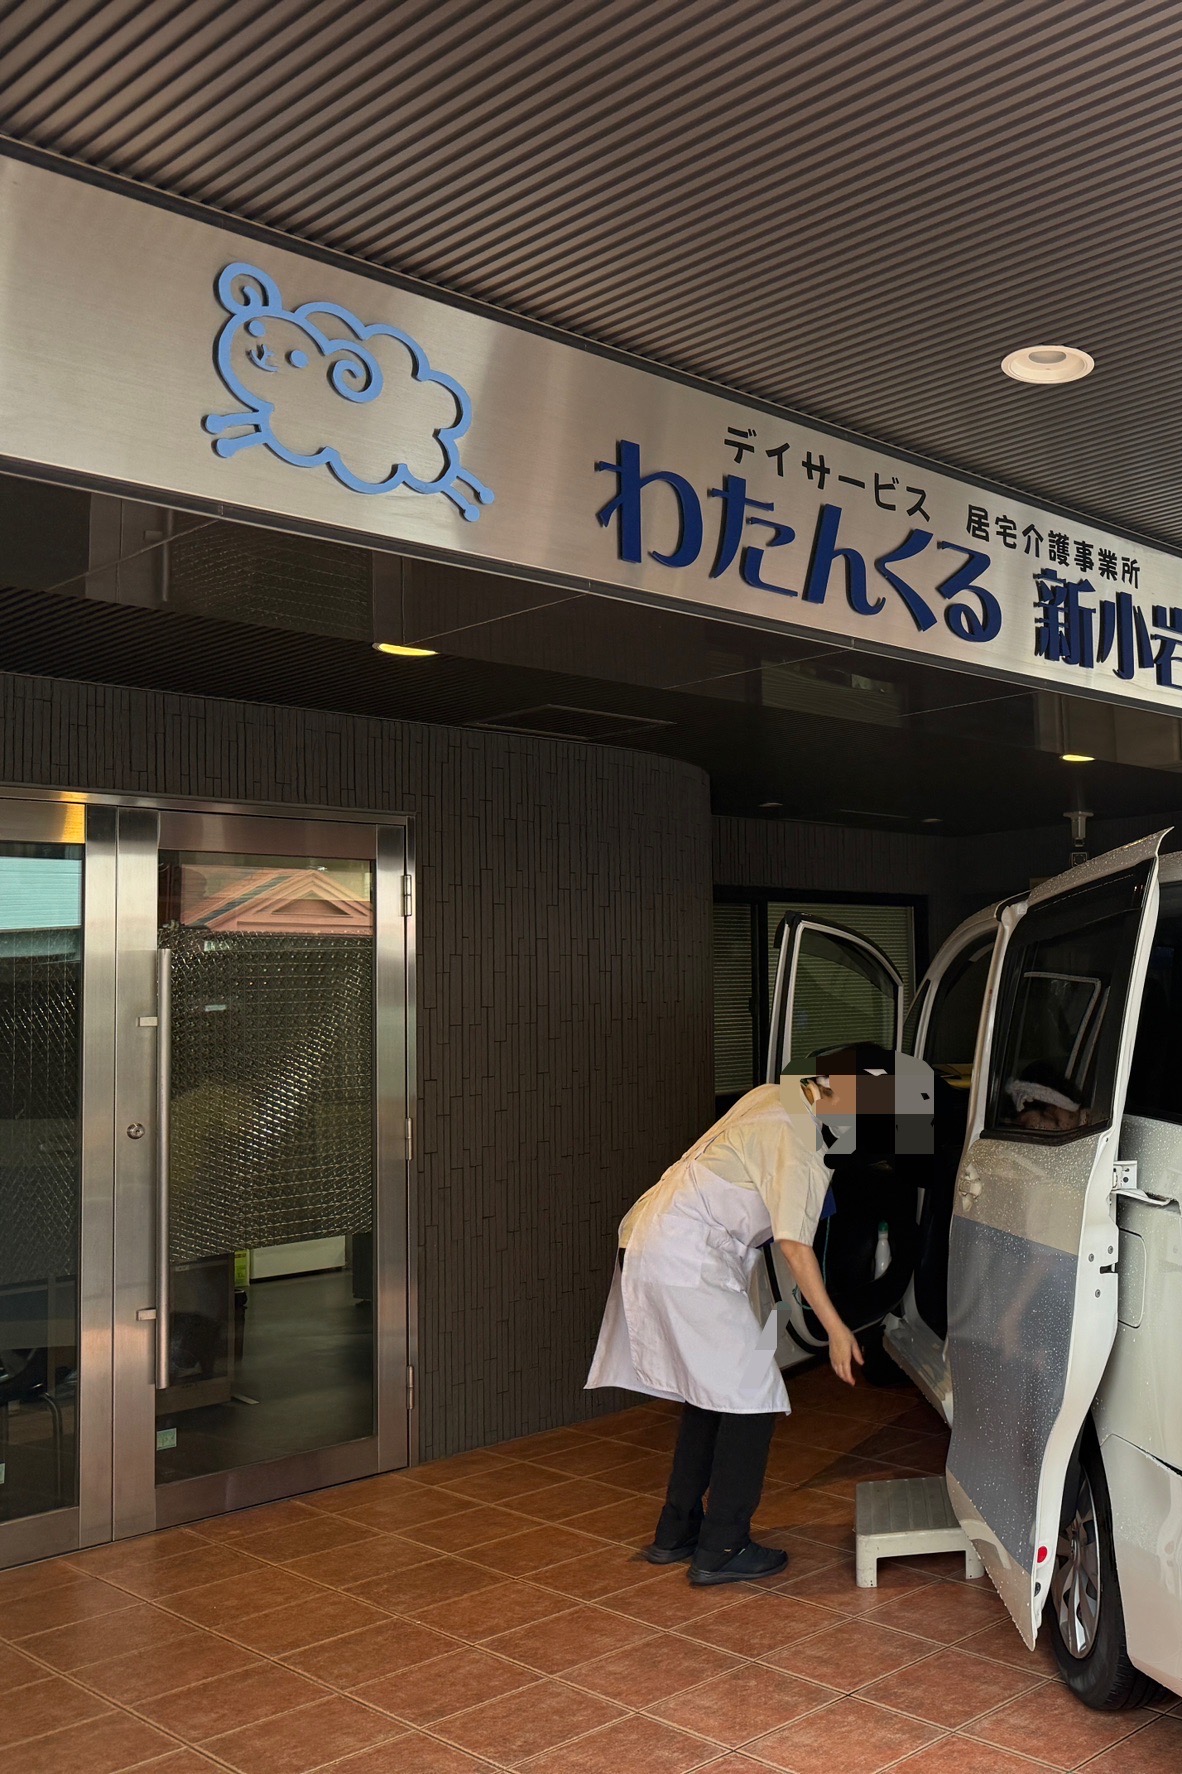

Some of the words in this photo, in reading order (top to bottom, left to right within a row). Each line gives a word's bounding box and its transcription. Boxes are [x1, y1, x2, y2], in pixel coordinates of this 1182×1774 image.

[594, 439, 1003, 643] わたんくる
[724, 426, 931, 520] デイサービス
[965, 504, 1141, 589] 居宅介護事業所
